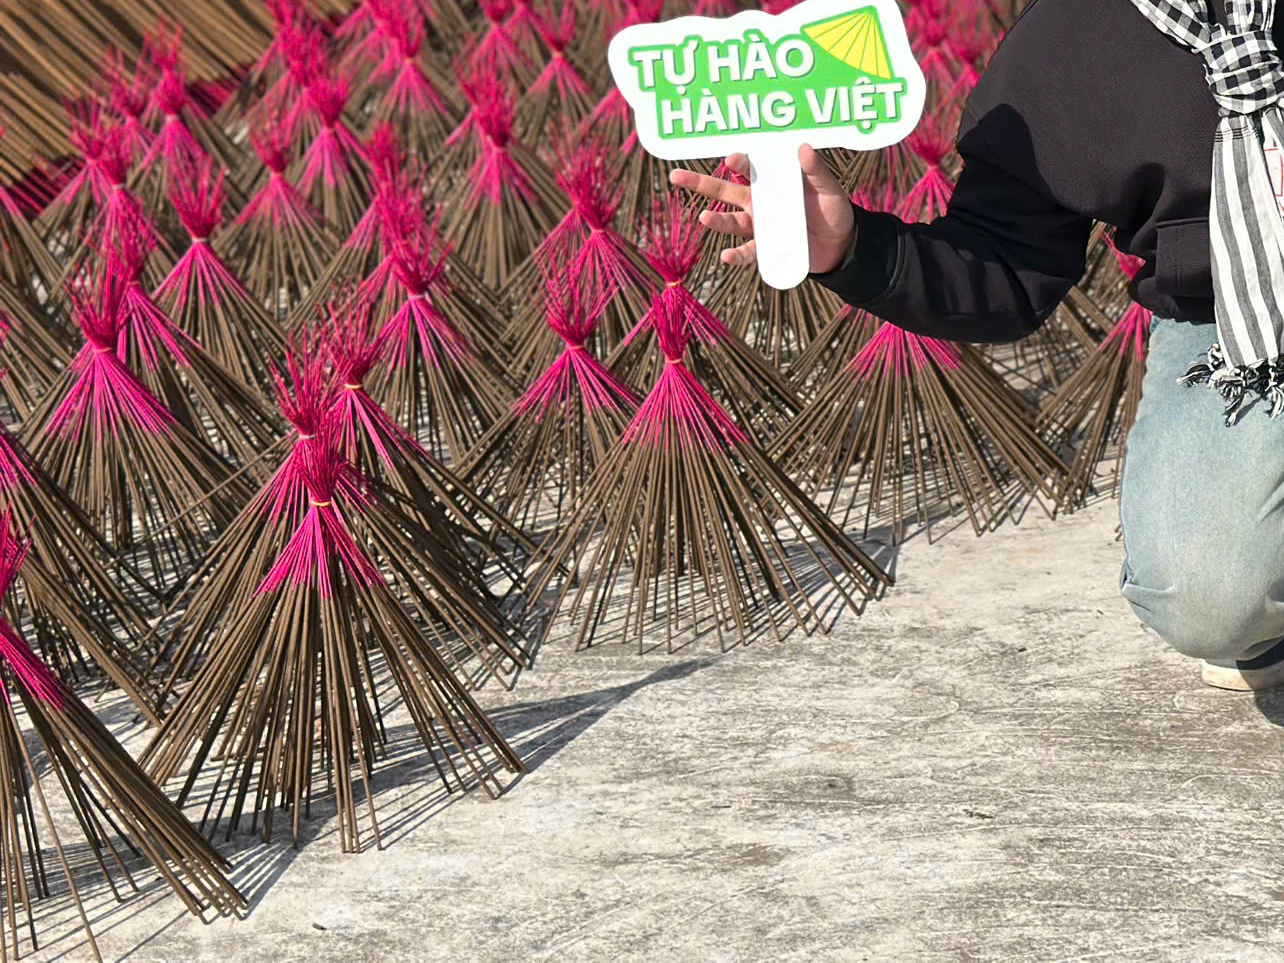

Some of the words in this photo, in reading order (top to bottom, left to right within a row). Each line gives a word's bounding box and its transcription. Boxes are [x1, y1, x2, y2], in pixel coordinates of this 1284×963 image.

[633, 40, 699, 95] TỰ
[707, 33, 814, 82] HÀO
[661, 88, 797, 135] HÀNG
[805, 76, 902, 130] VIỆT
